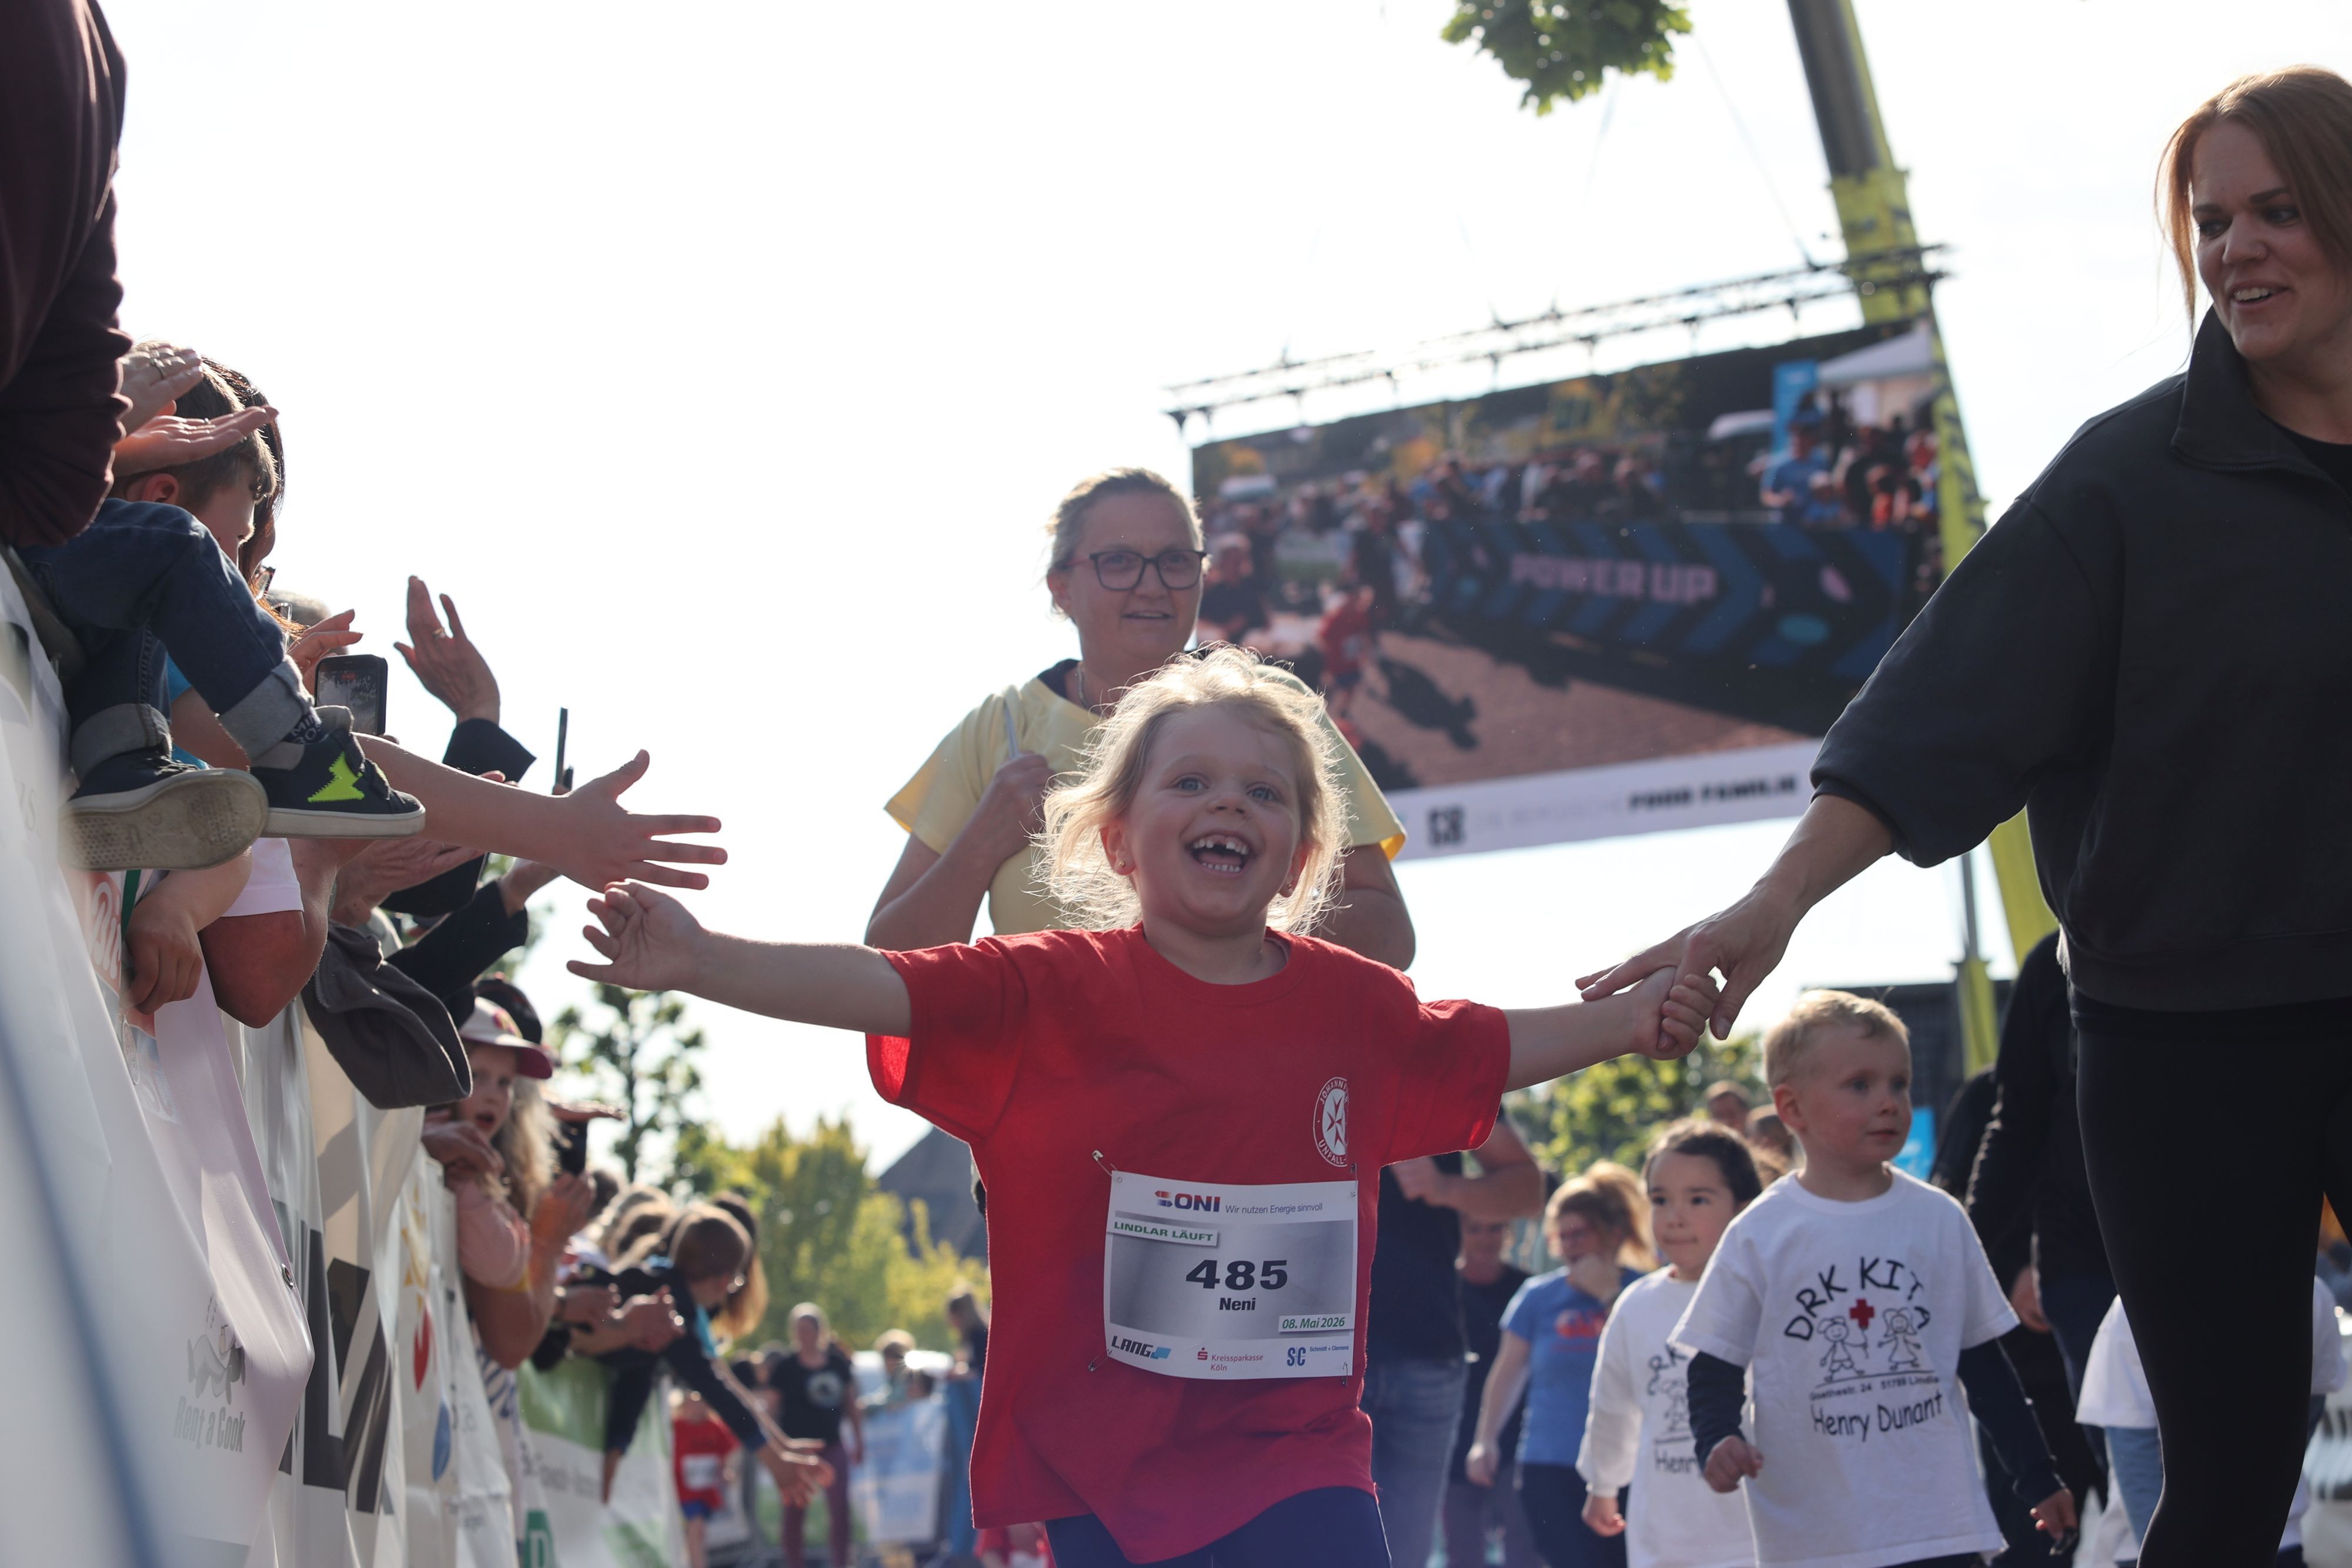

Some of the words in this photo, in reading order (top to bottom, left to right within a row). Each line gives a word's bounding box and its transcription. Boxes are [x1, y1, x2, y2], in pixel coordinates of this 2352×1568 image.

[1175, 1193, 1221, 1212] ONI
[1225, 1205, 1240, 1213] Wir
[1242, 1205, 1268, 1213] nutzen
[1270, 1205, 1296, 1215] Energie
[1297, 1202, 1322, 1212] sinnvoll
[1114, 1222, 1168, 1237] LINDLAR
[1172, 1229, 1213, 1242] LÄUFT
[1186, 1259, 1288, 1290] 485
[1220, 1297, 1256, 1310] Neni
[1784, 1264, 1847, 1341] DRK
[1282, 1319, 1297, 1329] 08.
[1299, 1318, 1319, 1328] Mai
[1321, 1317, 1345, 1328] 2026
[1111, 1335, 1154, 1358] LANG
[1211, 1355, 1264, 1363] Kreissparkasse
[1860, 1383, 1872, 1393] 24
[174, 1396, 205, 1450] Rent
[206, 1412, 216, 1445] a
[216, 1406, 246, 1453] Cook
[1811, 1404, 1870, 1442] Henry
[1877, 1390, 1942, 1432] Dunant
